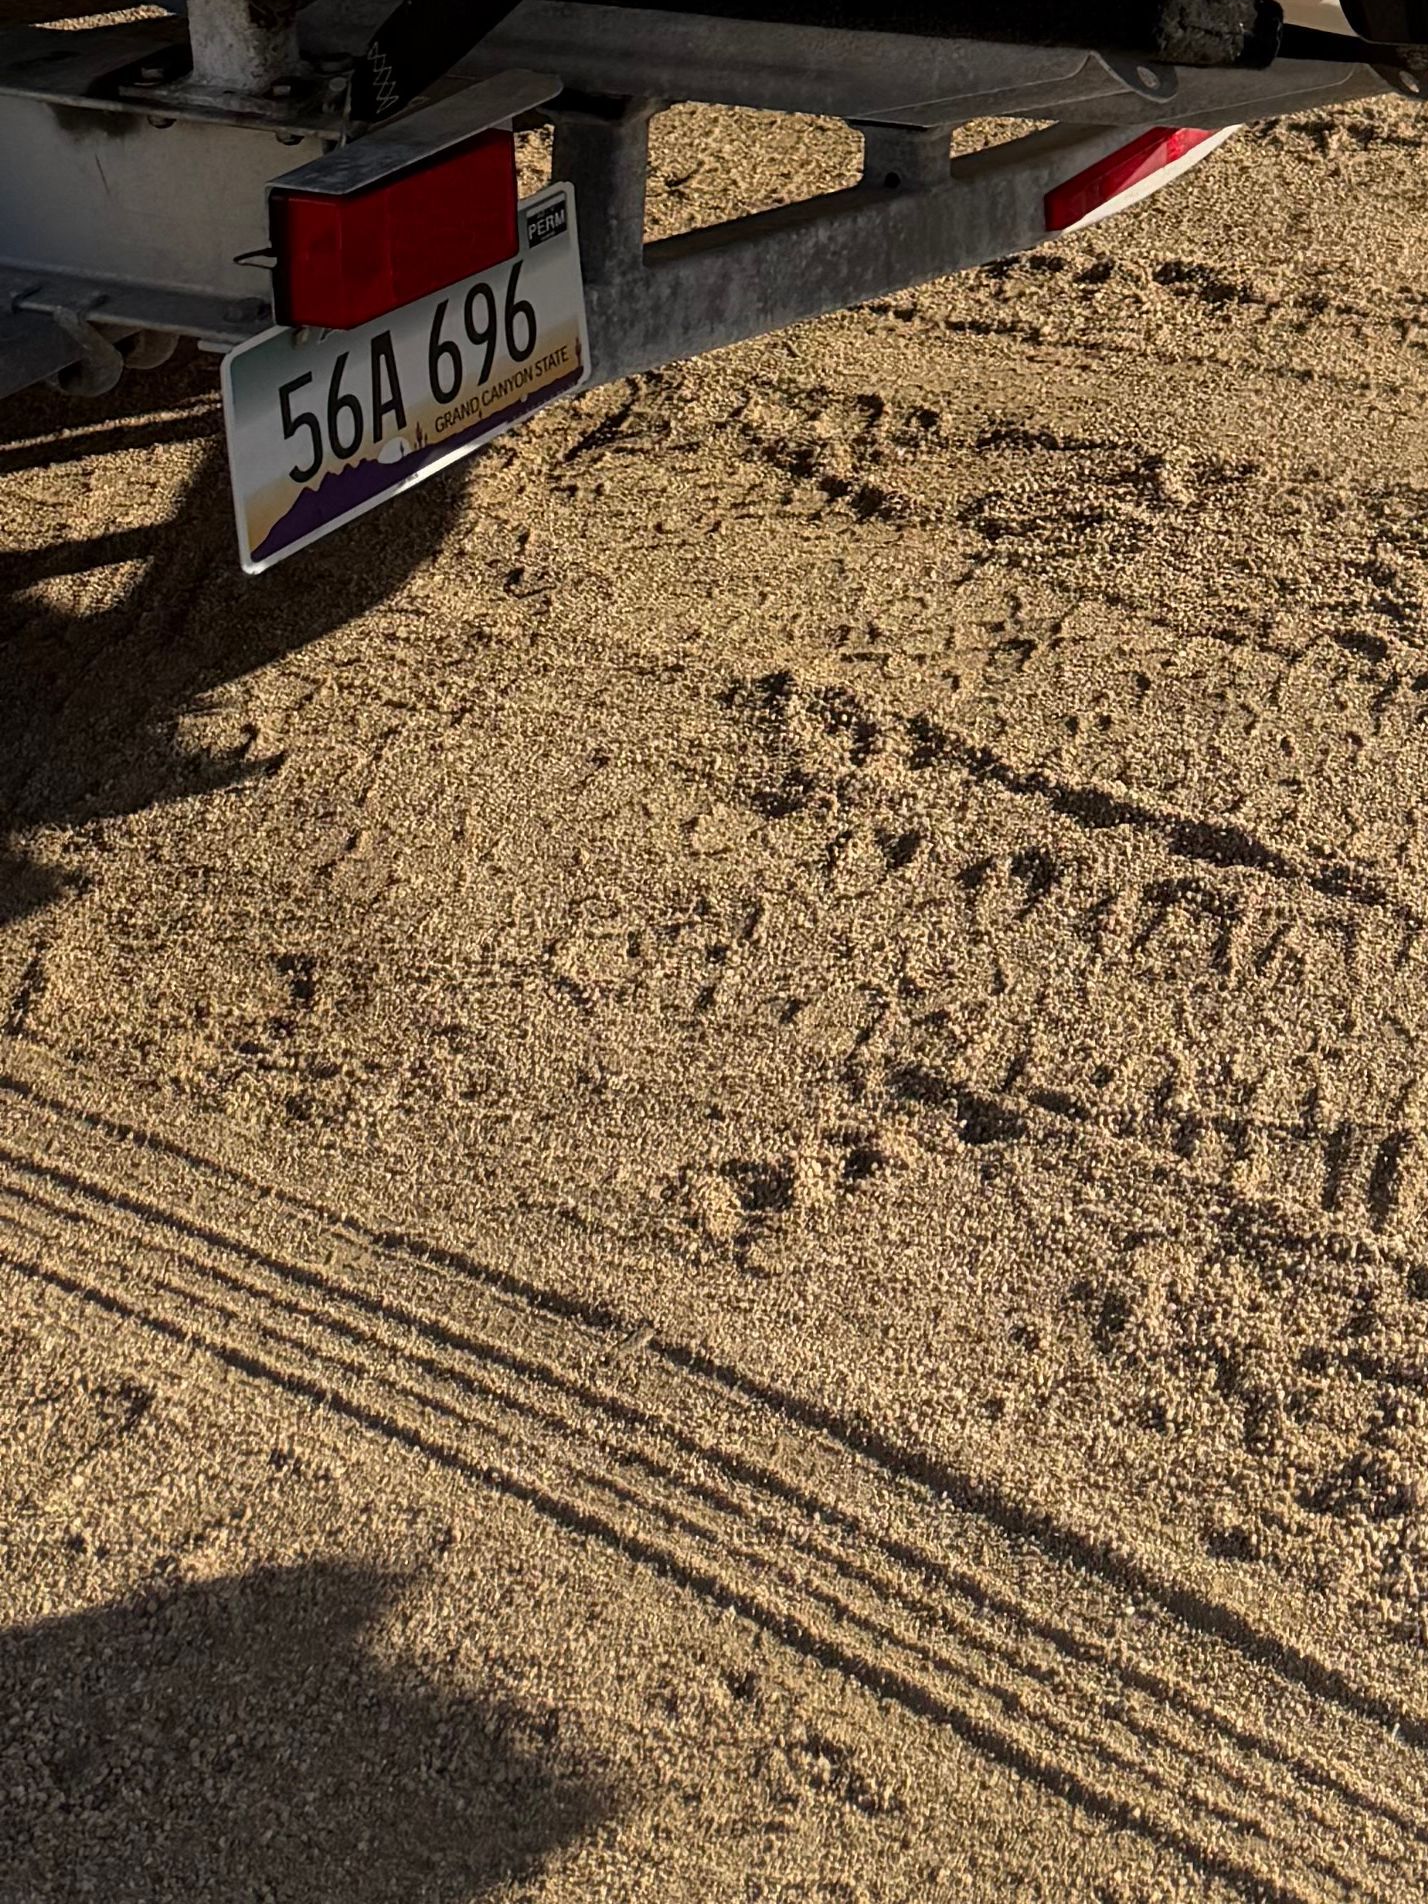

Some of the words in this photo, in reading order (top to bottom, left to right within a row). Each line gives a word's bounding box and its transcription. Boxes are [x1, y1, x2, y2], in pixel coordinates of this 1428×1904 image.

[528, 209, 565, 241] PERM
[278, 330, 407, 484] 56A
[428, 260, 538, 405] 696
[435, 396, 480, 433] GRAND
[481, 365, 533, 407] CANYON
[535, 345, 570, 377] STATE
